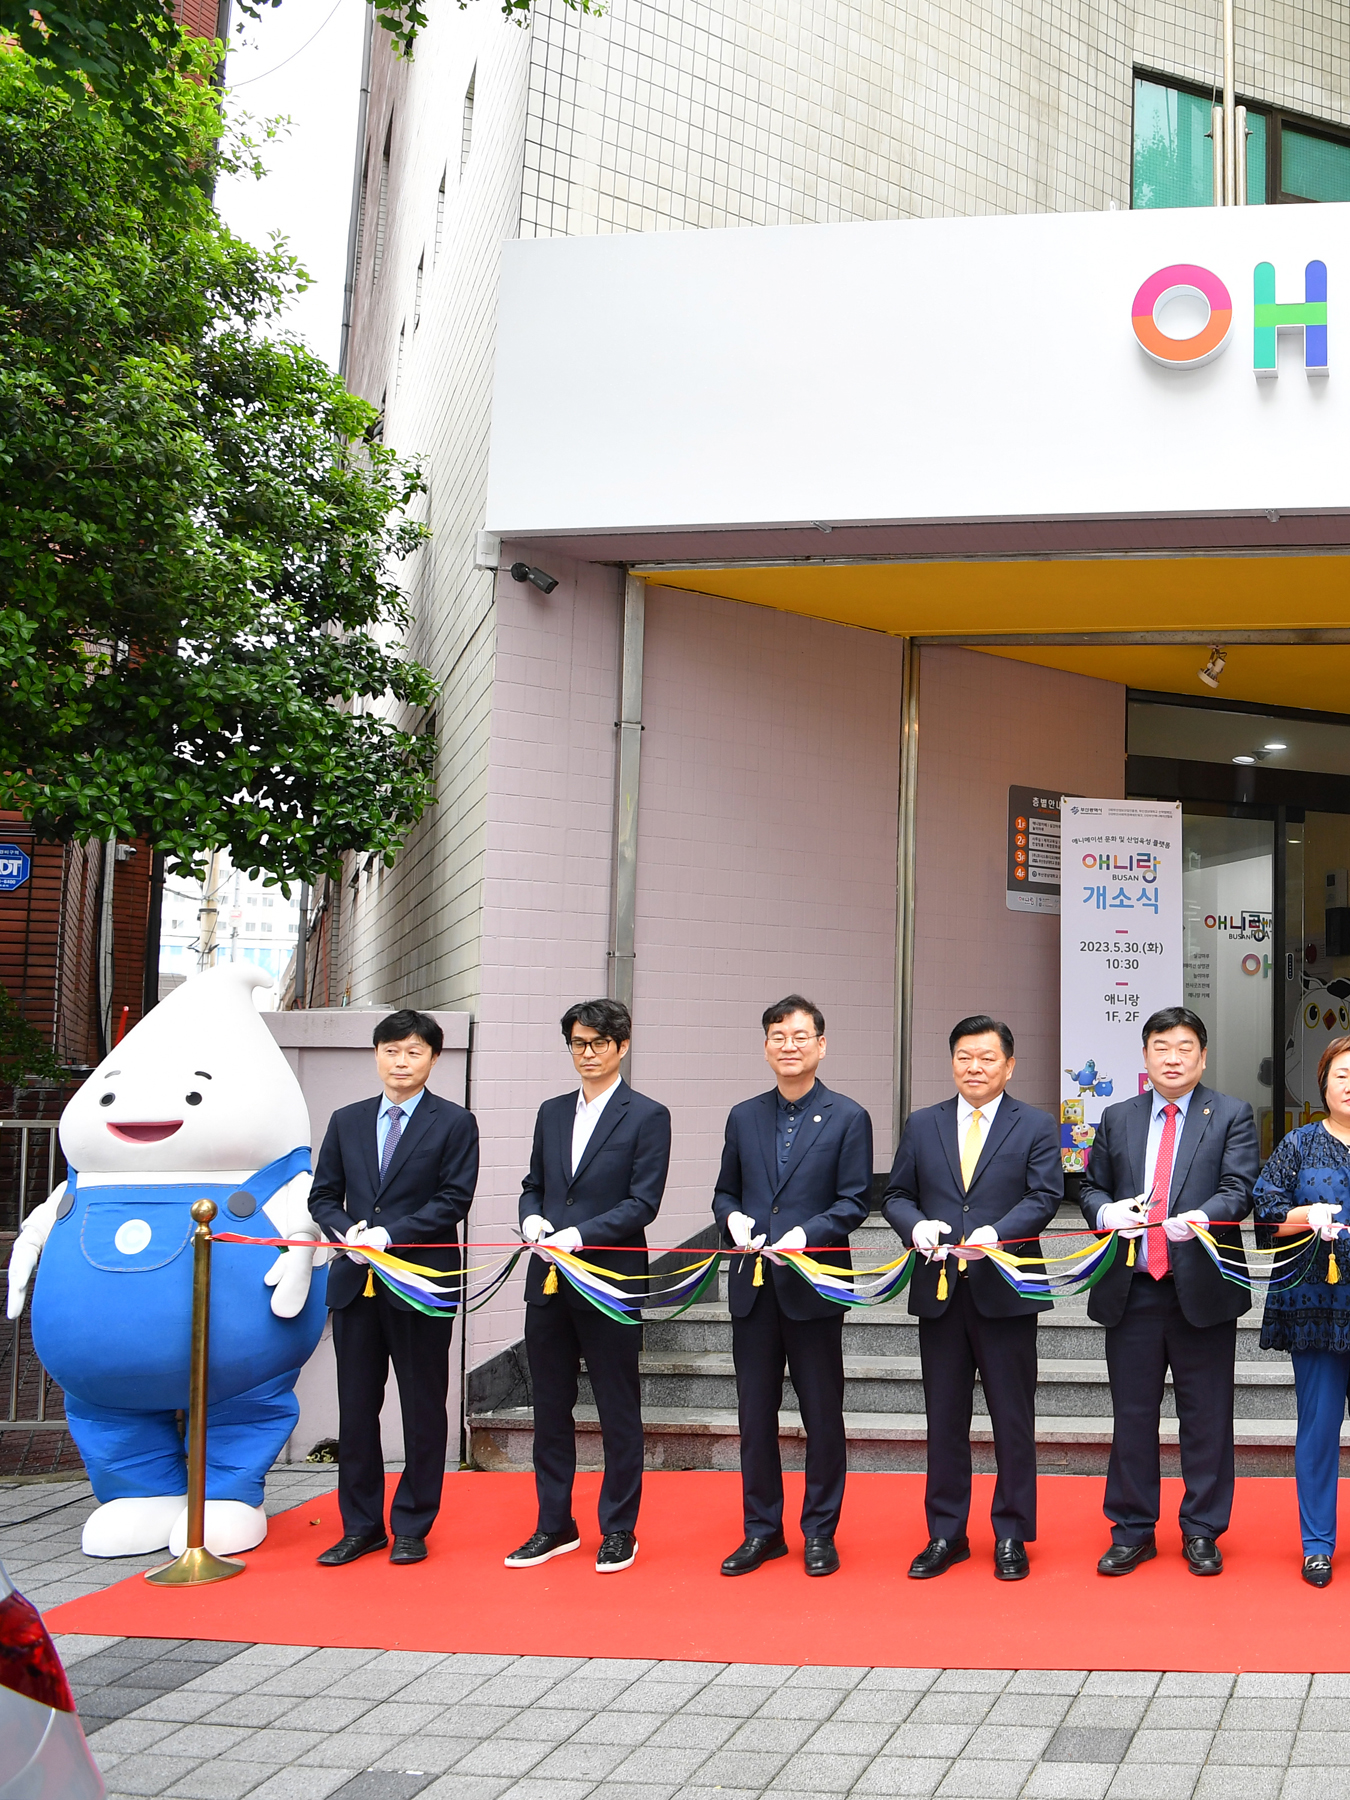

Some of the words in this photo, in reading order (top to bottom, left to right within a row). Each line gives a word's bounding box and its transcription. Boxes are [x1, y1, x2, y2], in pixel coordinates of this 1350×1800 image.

[1017, 819, 1026, 829] 1F
[1017, 835, 1026, 845] 2F
[1071, 835, 1103, 845] 애니메이션
[1126, 836, 1152, 846] 산업육성
[1152, 838, 1171, 850] 플랫폼
[1017, 852, 1026, 861] 3F
[0, 858, 22, 876] DT
[1016, 868, 1026, 878] 4F
[1082, 853, 1161, 884] 애니랑
[1112, 874, 1139, 882] BUSAN
[1083, 885, 1159, 915] 개소식
[1204, 914, 1268, 942] 애니랑
[1079, 941, 1164, 955] 2023.5.30.(화)
[1105, 958, 1140, 970] 10:30
[1104, 993, 1140, 1007] 애니랑
[1105, 1011, 1121, 1023] 1F,
[1125, 1011, 1140, 1022] 2F
